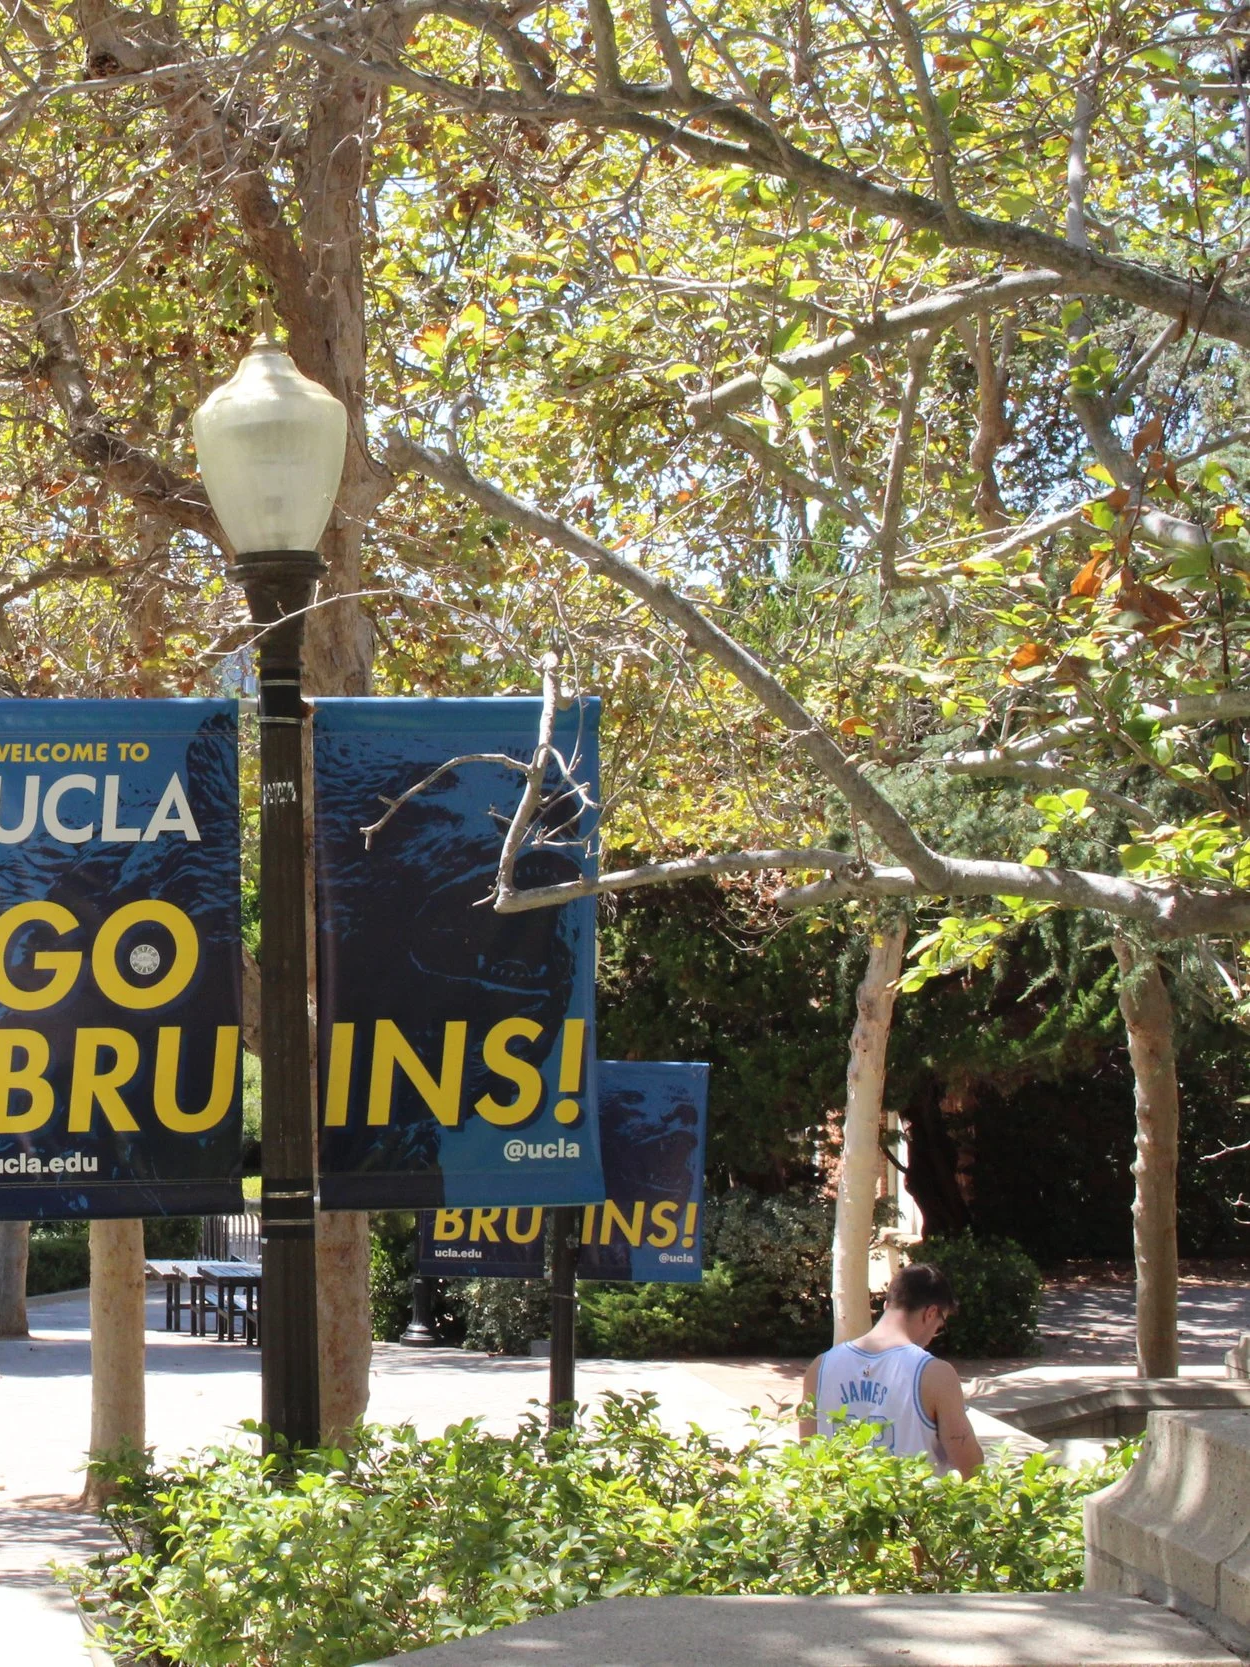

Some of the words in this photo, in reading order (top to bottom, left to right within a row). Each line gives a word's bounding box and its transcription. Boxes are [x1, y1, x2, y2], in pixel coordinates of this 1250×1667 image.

[117, 742, 150, 763] TO
[503, 1138, 580, 1162] @ucla
[434, 1247, 482, 1259] ucla.edu
[658, 1252, 694, 1264] @ucla
[840, 1379, 888, 1407] JAMES
